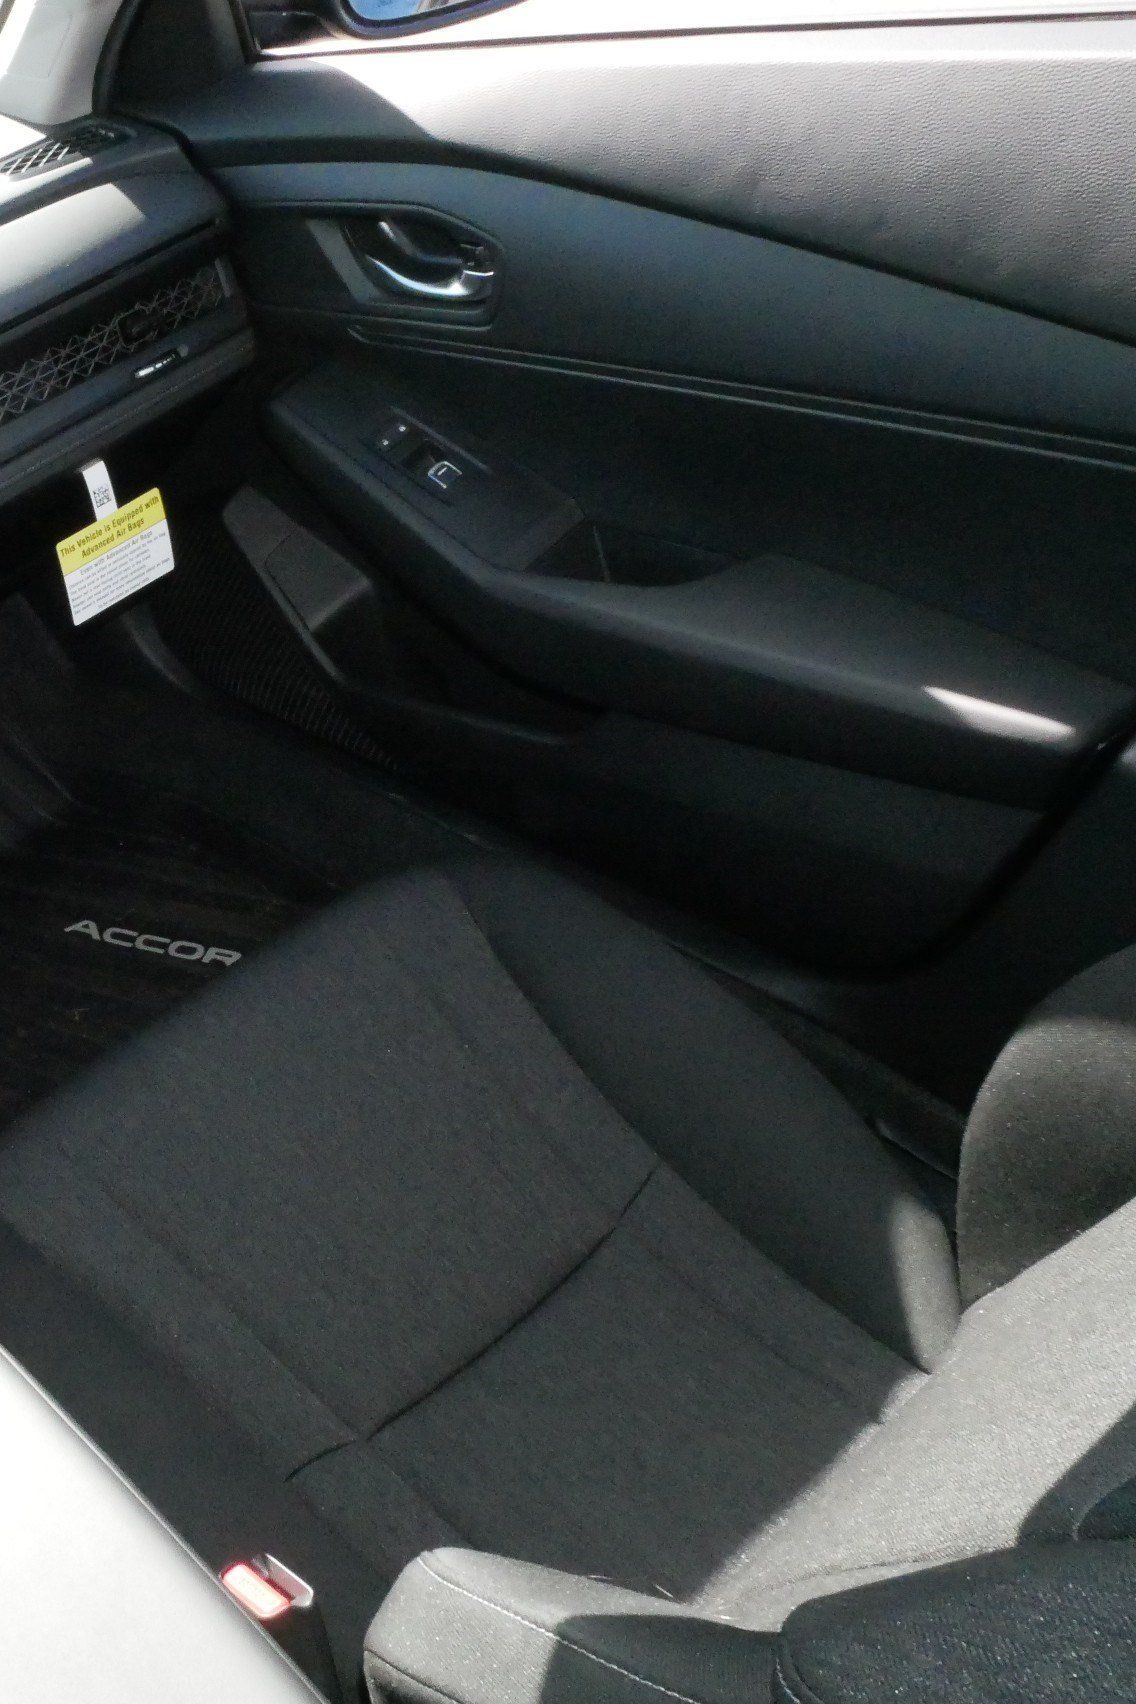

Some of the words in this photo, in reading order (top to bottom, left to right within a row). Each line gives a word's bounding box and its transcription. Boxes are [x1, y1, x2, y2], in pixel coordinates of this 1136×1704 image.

[60, 542, 76, 557] This
[76, 530, 103, 548] Vehicle
[104, 524, 111, 534] is
[112, 505, 144, 529] Equipped
[145, 496, 160, 510] with
[81, 535, 114, 558] Advanced
[116, 525, 126, 538] Air
[128, 518, 145, 532] Bags
[64, 919, 242, 966] ACCOR
